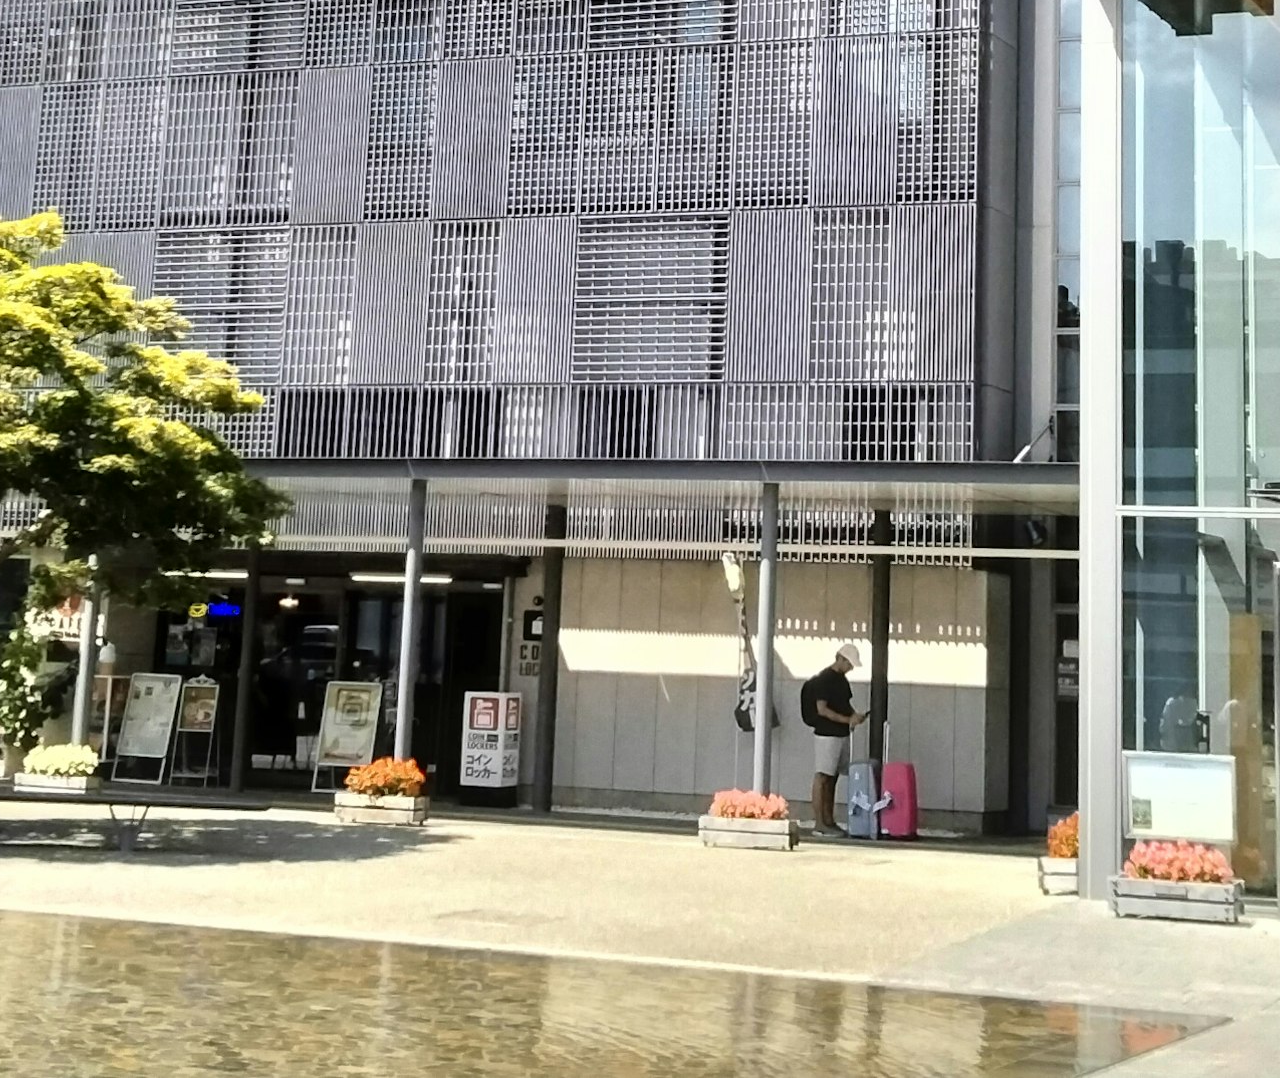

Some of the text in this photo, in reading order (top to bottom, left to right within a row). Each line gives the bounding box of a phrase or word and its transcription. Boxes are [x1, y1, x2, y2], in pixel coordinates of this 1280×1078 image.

[520, 644, 540, 660] CO
[466, 754, 493, 766] コイン
[465, 766, 497, 779] ロッカー
